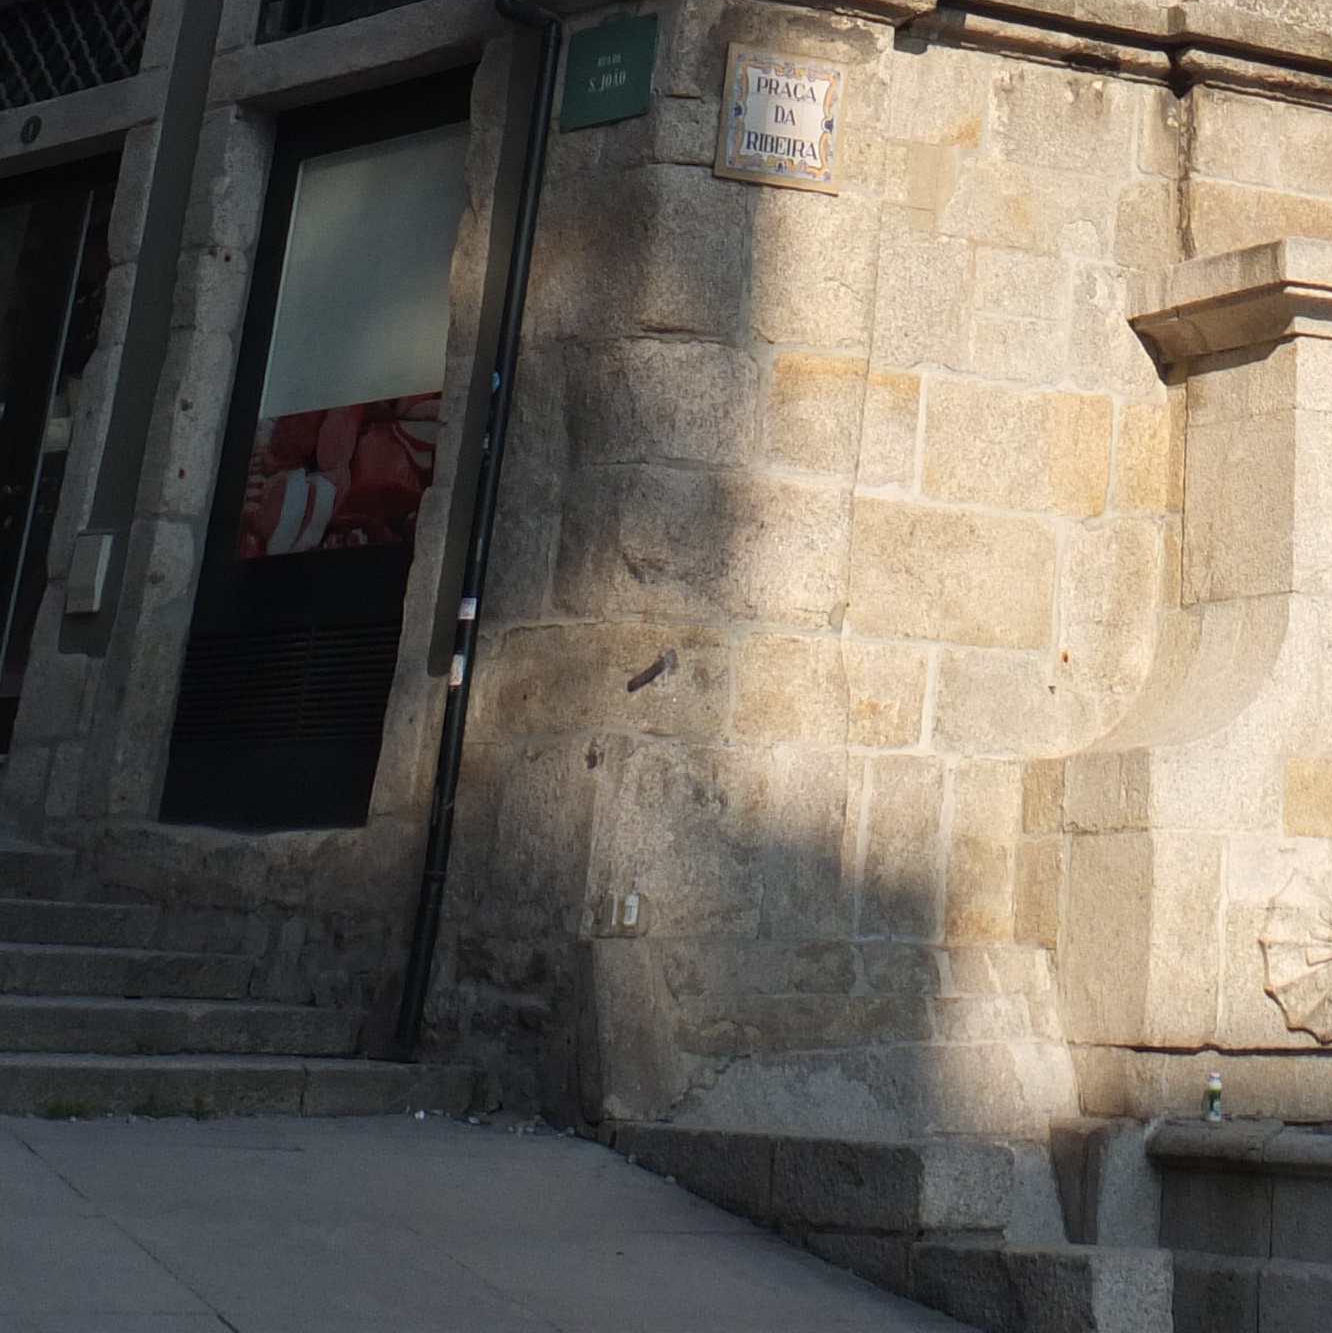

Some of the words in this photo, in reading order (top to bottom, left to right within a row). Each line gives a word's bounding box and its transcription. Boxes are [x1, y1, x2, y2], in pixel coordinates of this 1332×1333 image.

[599, 68, 626, 92] JOÃO
[757, 76, 816, 102] PRAÇA
[774, 105, 795, 126] DA
[746, 131, 817, 160] RIBEIRA
